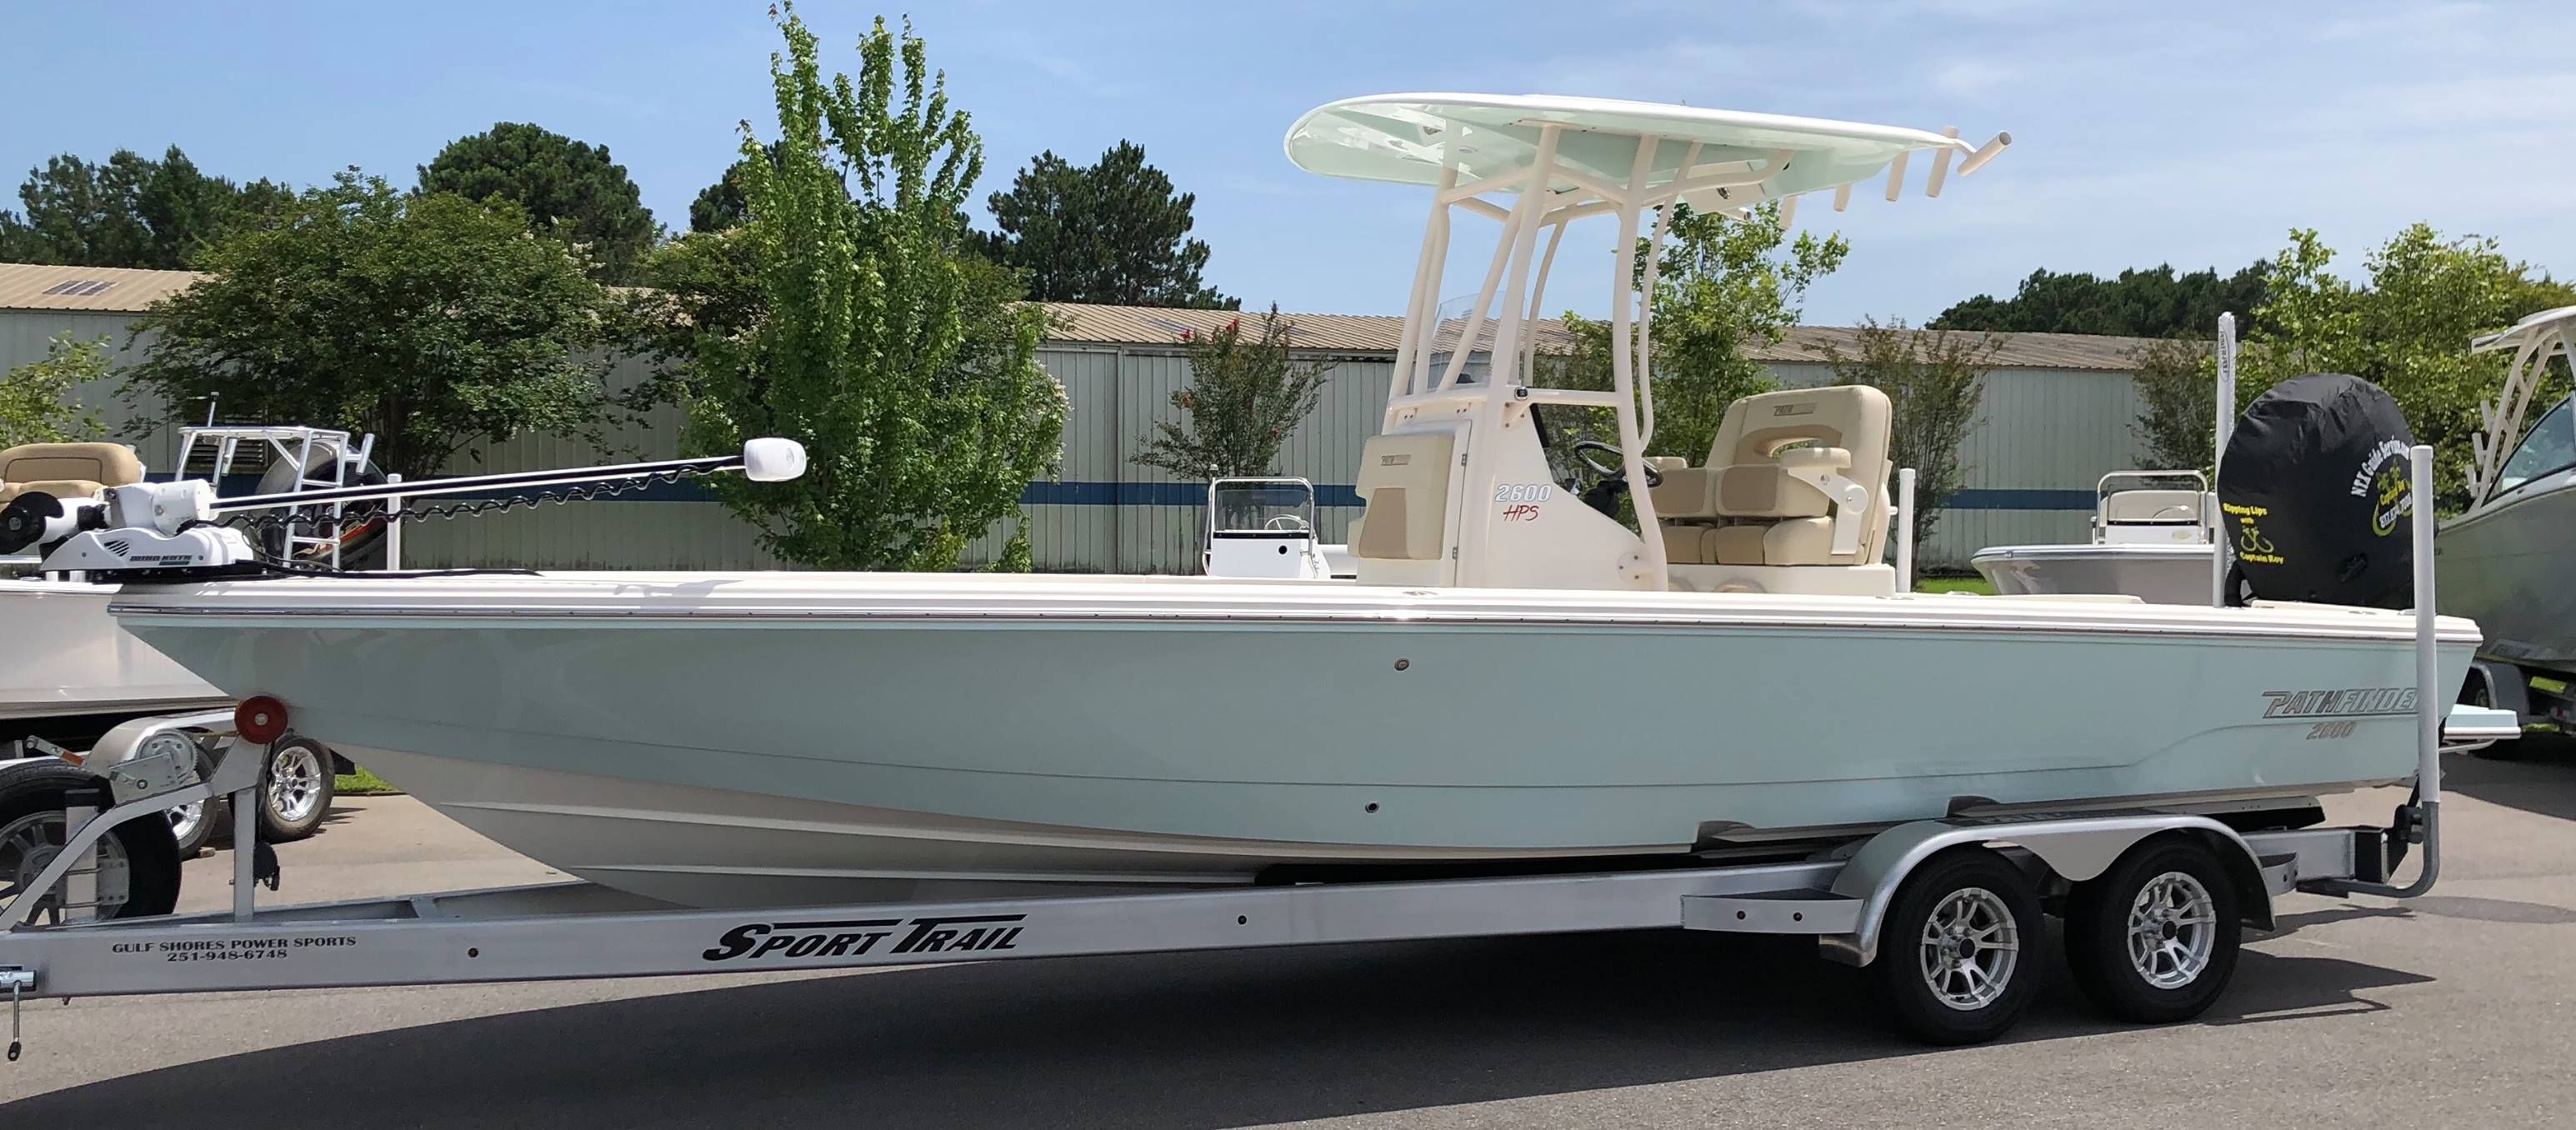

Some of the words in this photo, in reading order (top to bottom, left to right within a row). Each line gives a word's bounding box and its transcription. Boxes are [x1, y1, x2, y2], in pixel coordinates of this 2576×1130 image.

[1494, 483, 1553, 502] 2600
[1503, 504, 1539, 522] HPS
[2250, 505, 2268, 517] Lips
[2262, 688, 2418, 719] PATHFINDE
[112, 942, 154, 953] GULF
[159, 940, 225, 952] SHORES
[231, 938, 288, 949] POWER
[293, 936, 357, 948] SPORTS
[702, 919, 903, 962] SPORT
[888, 914, 1028, 954] TRAIL
[167, 949, 288, 962] 251-948-6748
